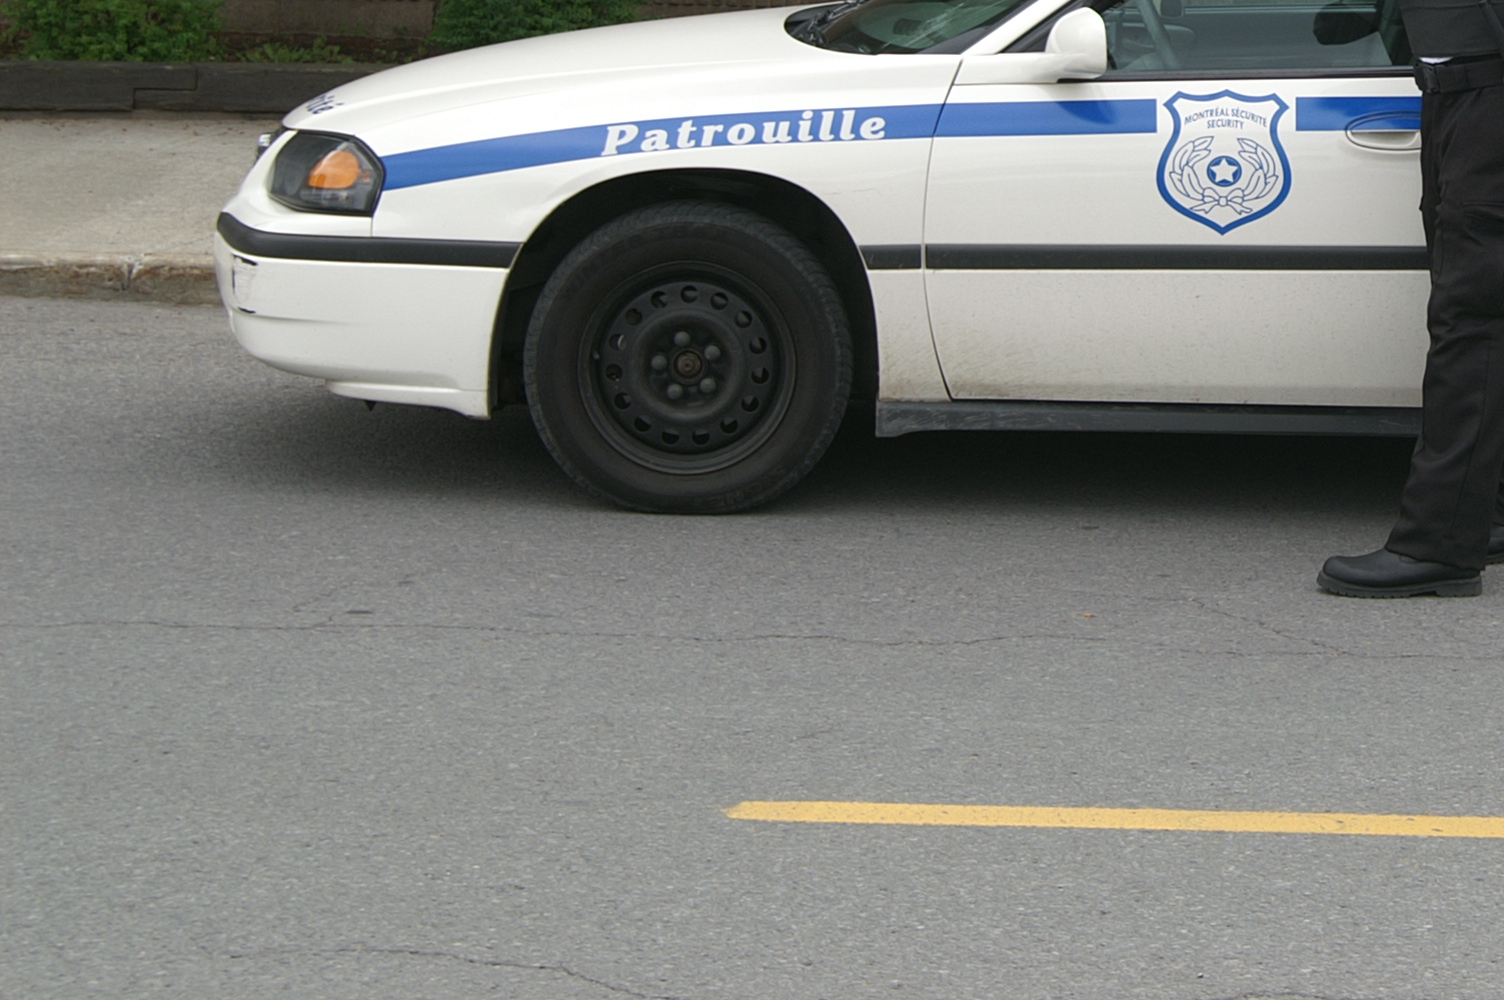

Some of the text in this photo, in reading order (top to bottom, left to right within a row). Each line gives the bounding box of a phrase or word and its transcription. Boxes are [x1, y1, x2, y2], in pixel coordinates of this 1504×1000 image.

[1184, 106, 1229, 125] MONTRÉAL
[1207, 119, 1244, 130] SECURITY
[601, 110, 886, 157] Patrouille
